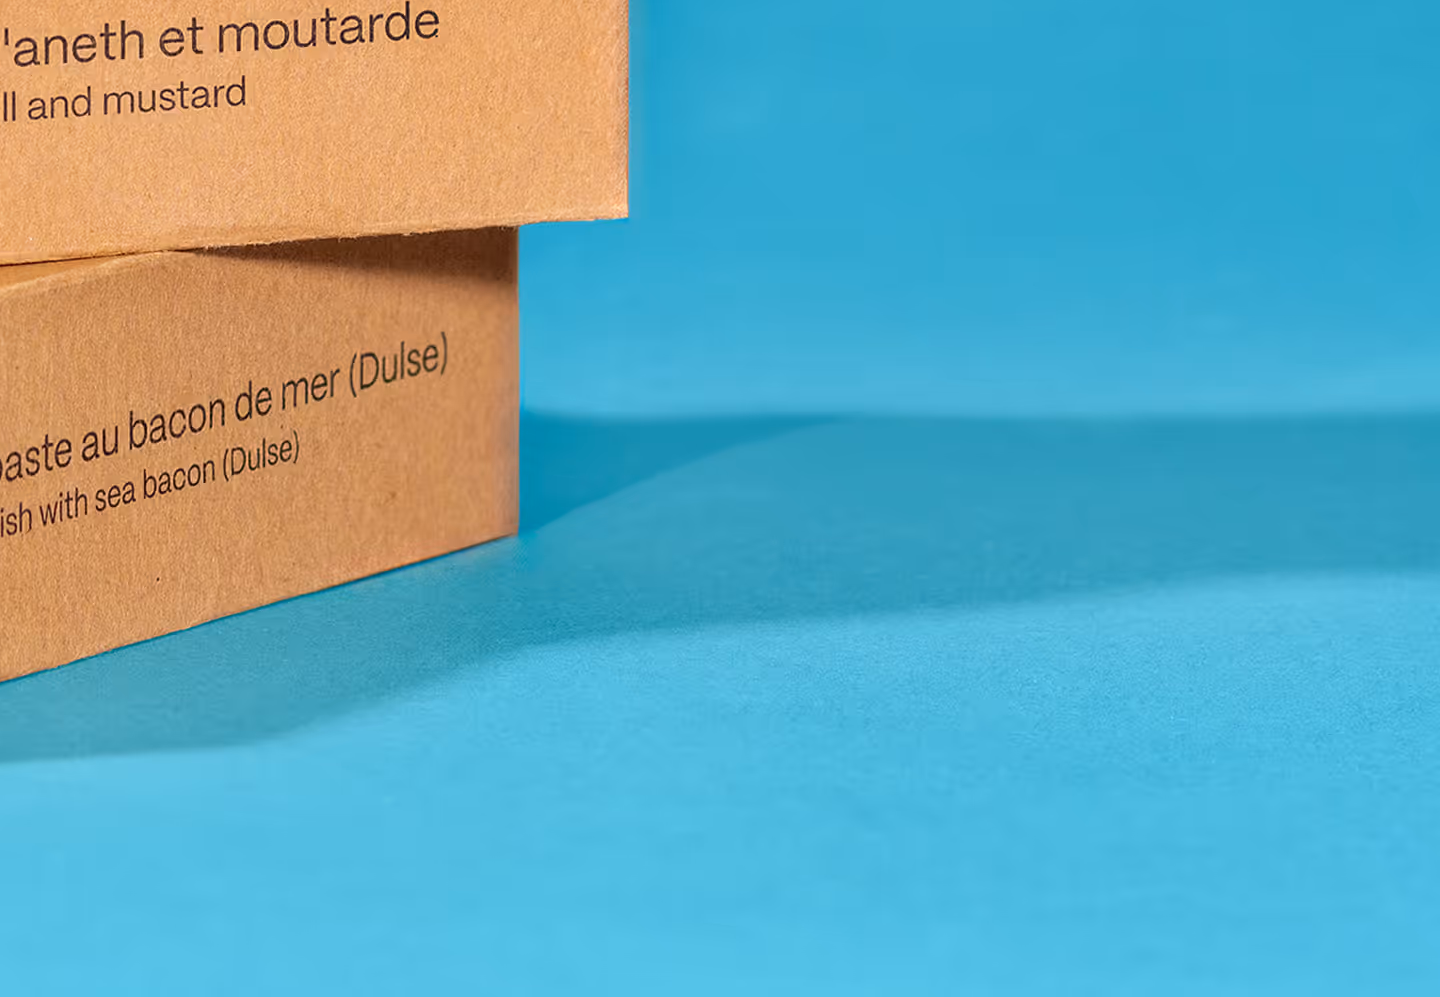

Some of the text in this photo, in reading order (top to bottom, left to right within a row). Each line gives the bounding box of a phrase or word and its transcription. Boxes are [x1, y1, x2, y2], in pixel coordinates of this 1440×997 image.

[160, 16, 204, 57] et
[218, 0, 440, 54] moutarde
[28, 86, 92, 121] and
[103, 75, 247, 116] mustard
[82, 426, 120, 463] au
[129, 399, 226, 450] bacon
[235, 380, 273, 423] de
[281, 367, 341, 411] mer
[349, 332, 448, 398] (Dulse)
[39, 487, 88, 527] with
[95, 481, 137, 513] sea
[144, 460, 216, 500] bacon
[222, 431, 300, 483] (Dulse)
